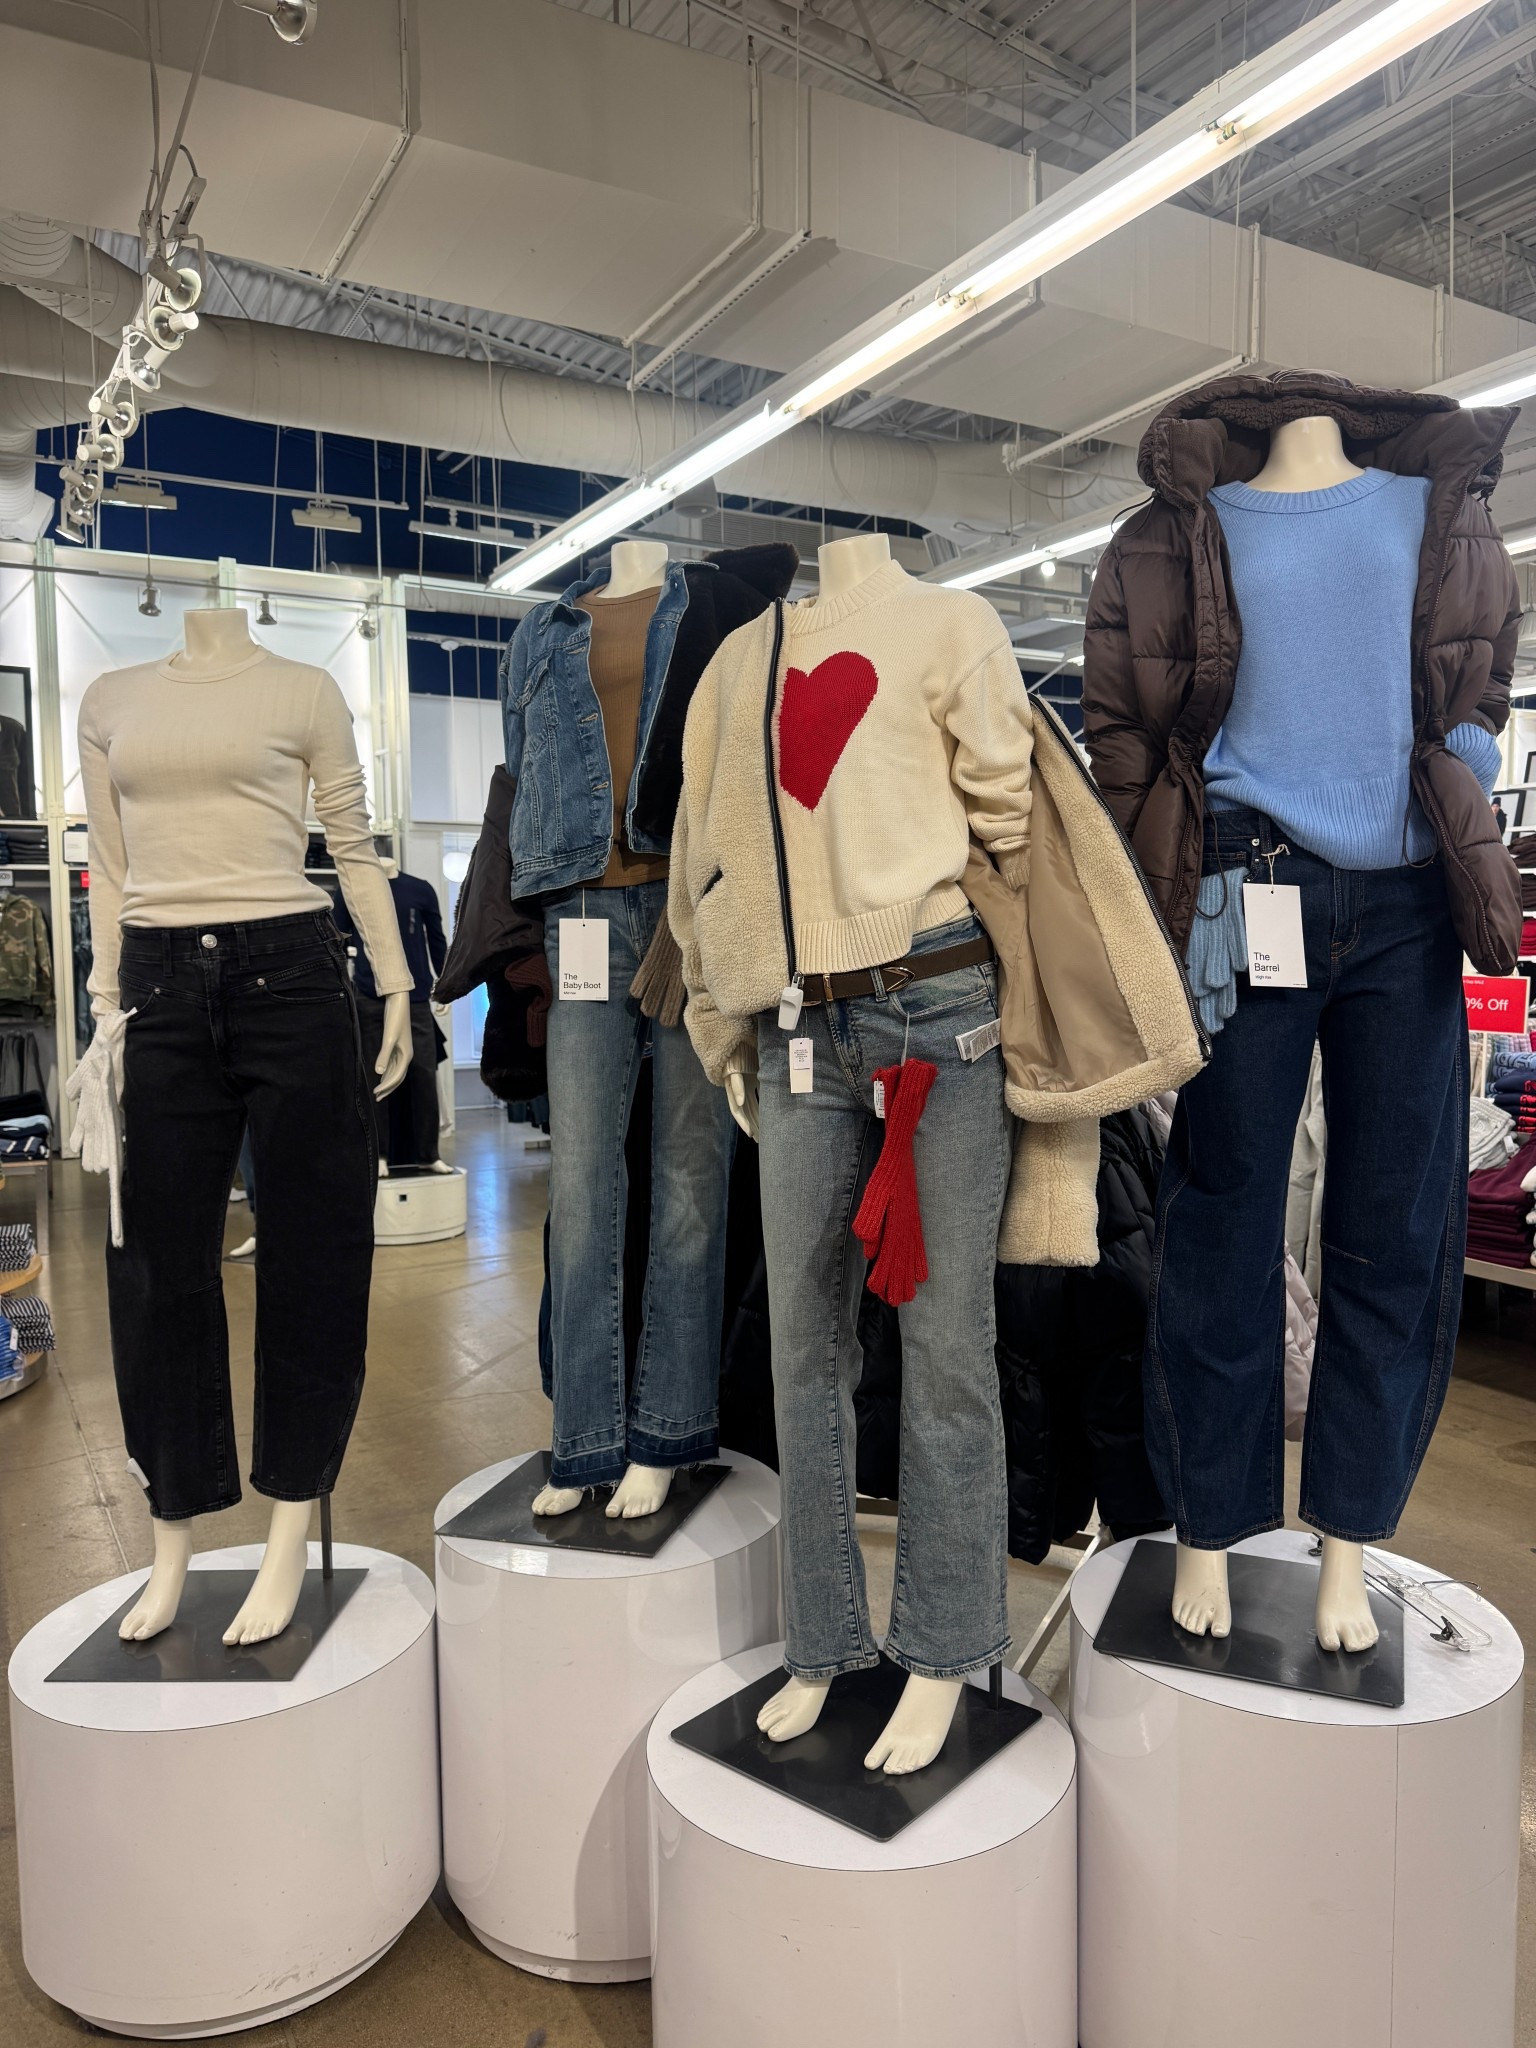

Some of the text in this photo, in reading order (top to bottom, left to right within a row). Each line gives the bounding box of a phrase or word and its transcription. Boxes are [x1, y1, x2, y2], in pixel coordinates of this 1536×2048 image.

[1254, 952, 1270, 961] The
[1254, 962, 1280, 972] Barrel
[563, 981, 601, 990] Baby Boot
[1488, 998, 1509, 1011] Off
